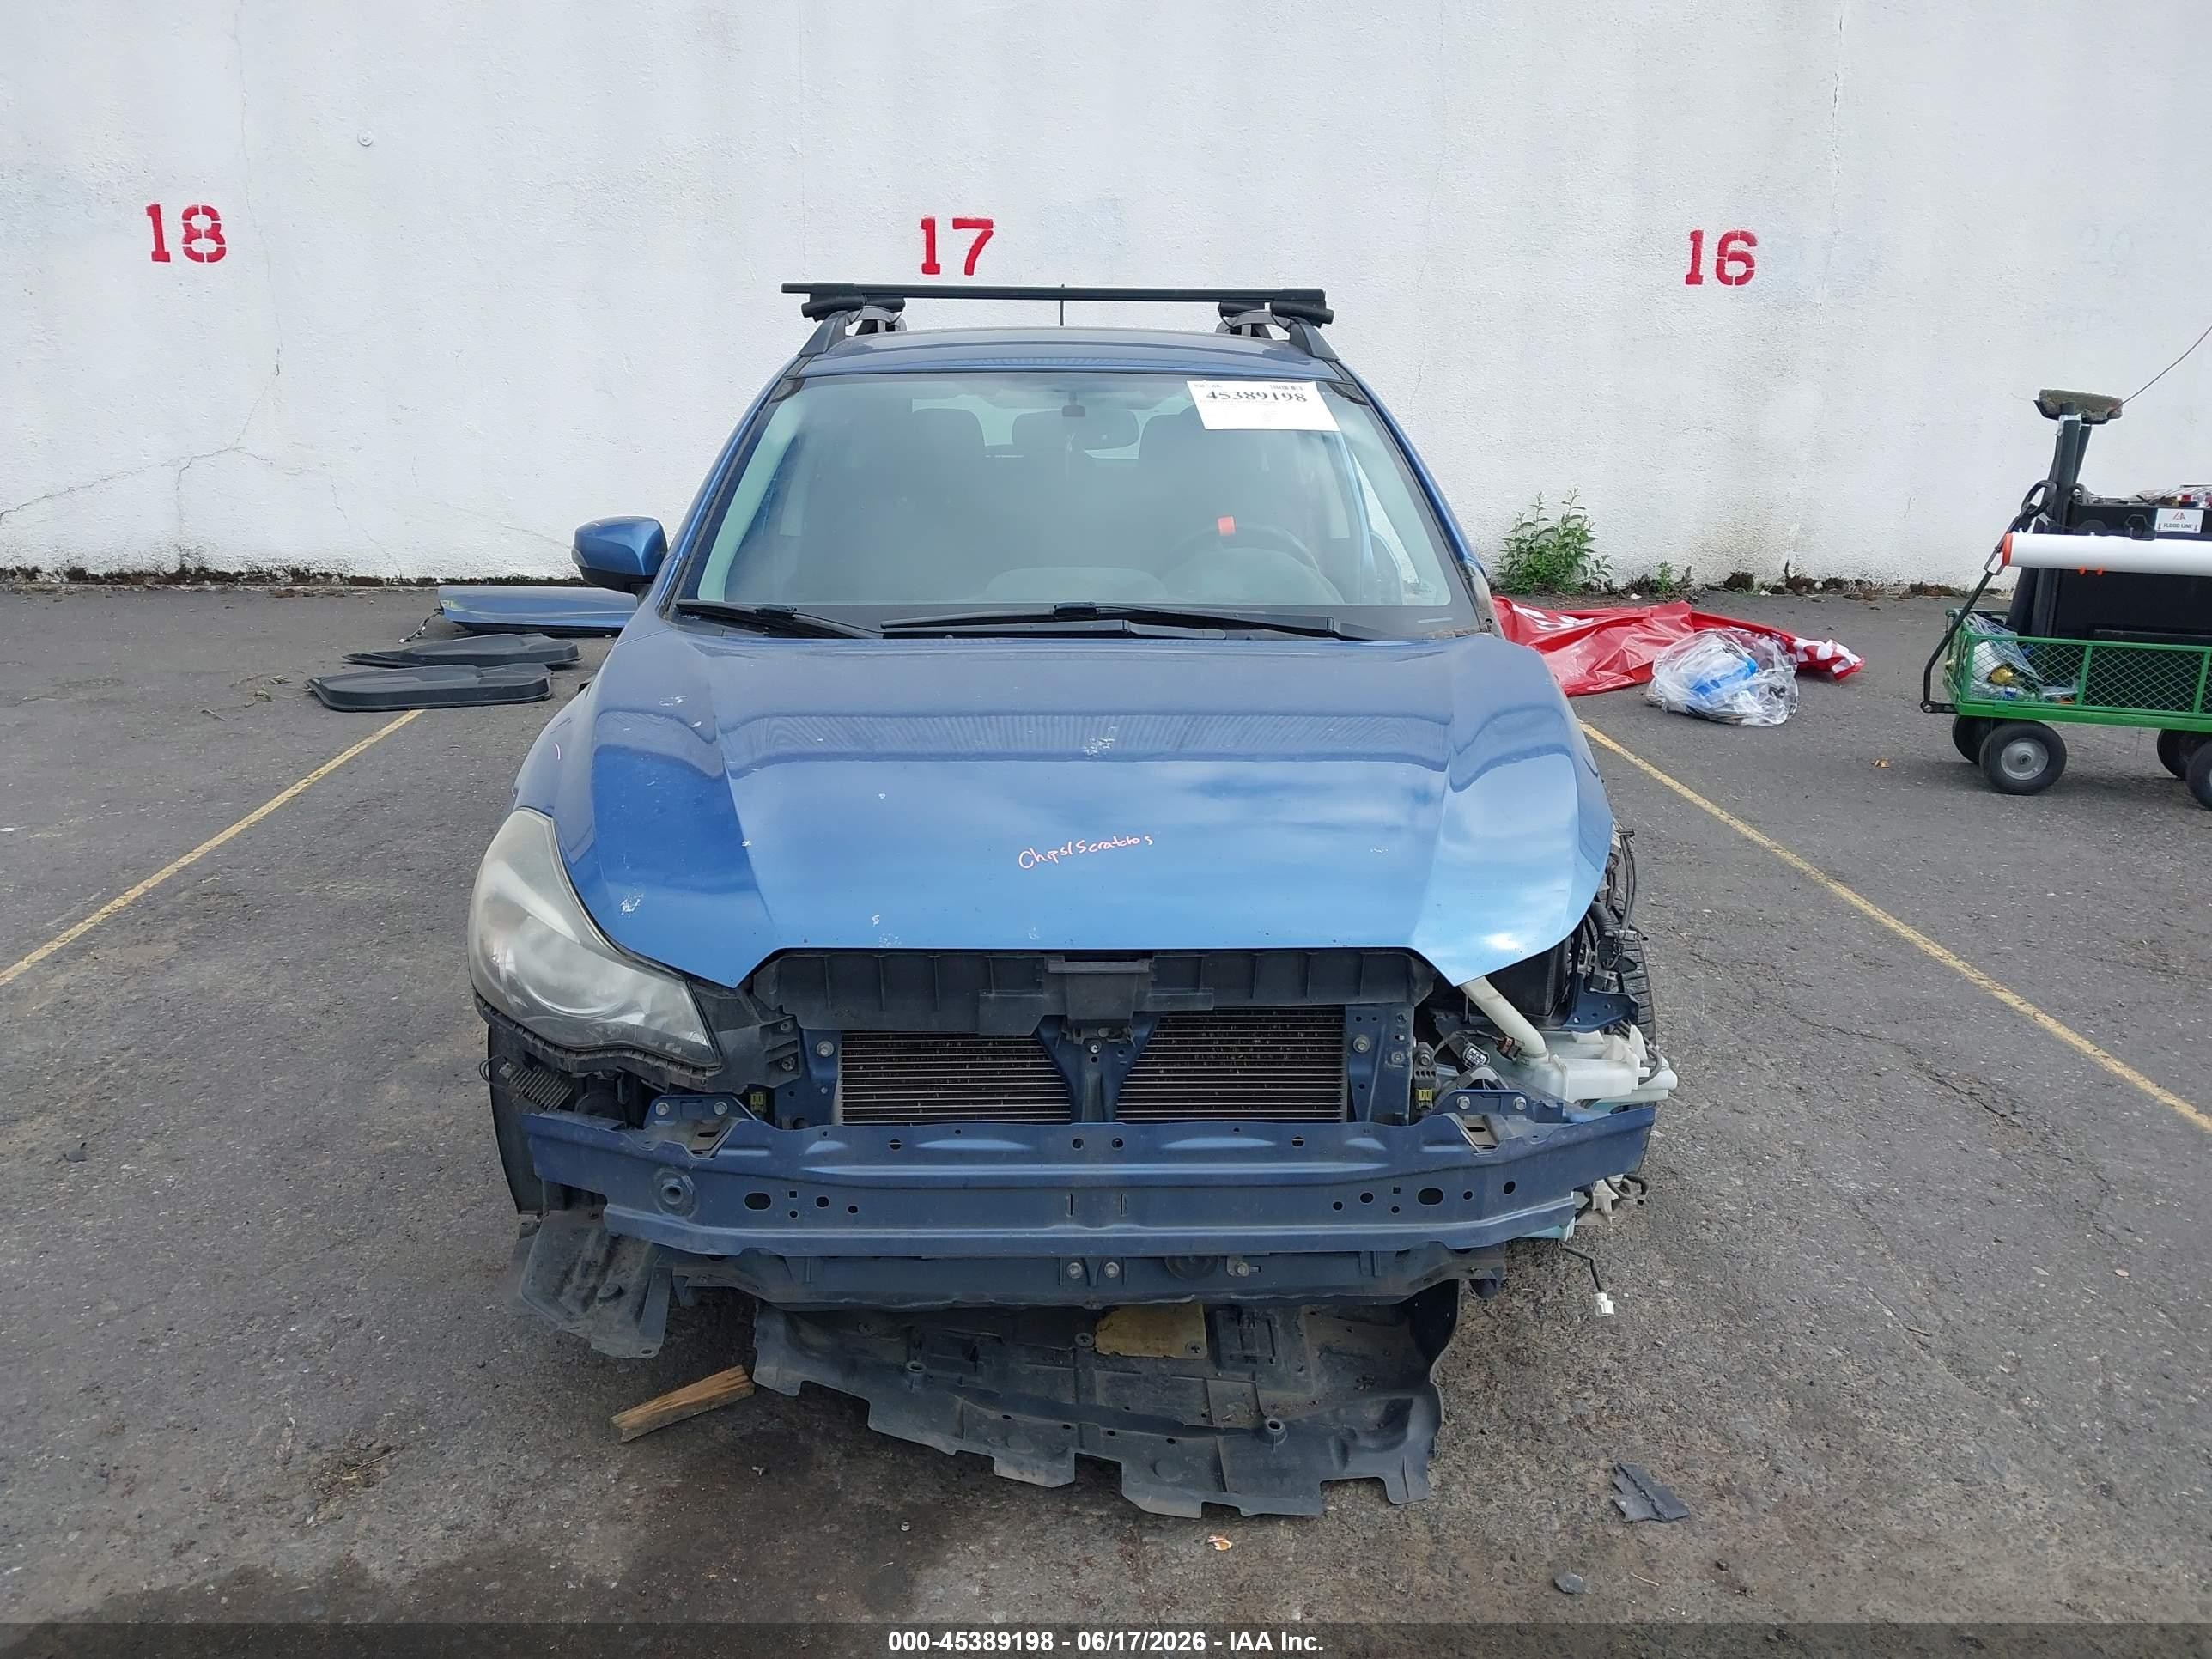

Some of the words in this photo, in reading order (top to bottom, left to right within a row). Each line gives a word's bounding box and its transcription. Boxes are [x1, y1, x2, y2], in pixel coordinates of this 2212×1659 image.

[147, 204, 228, 264] 18
[921, 216, 994, 276] 17
[1685, 229, 1759, 286] 16
[1206, 390, 1308, 403] 45389198
